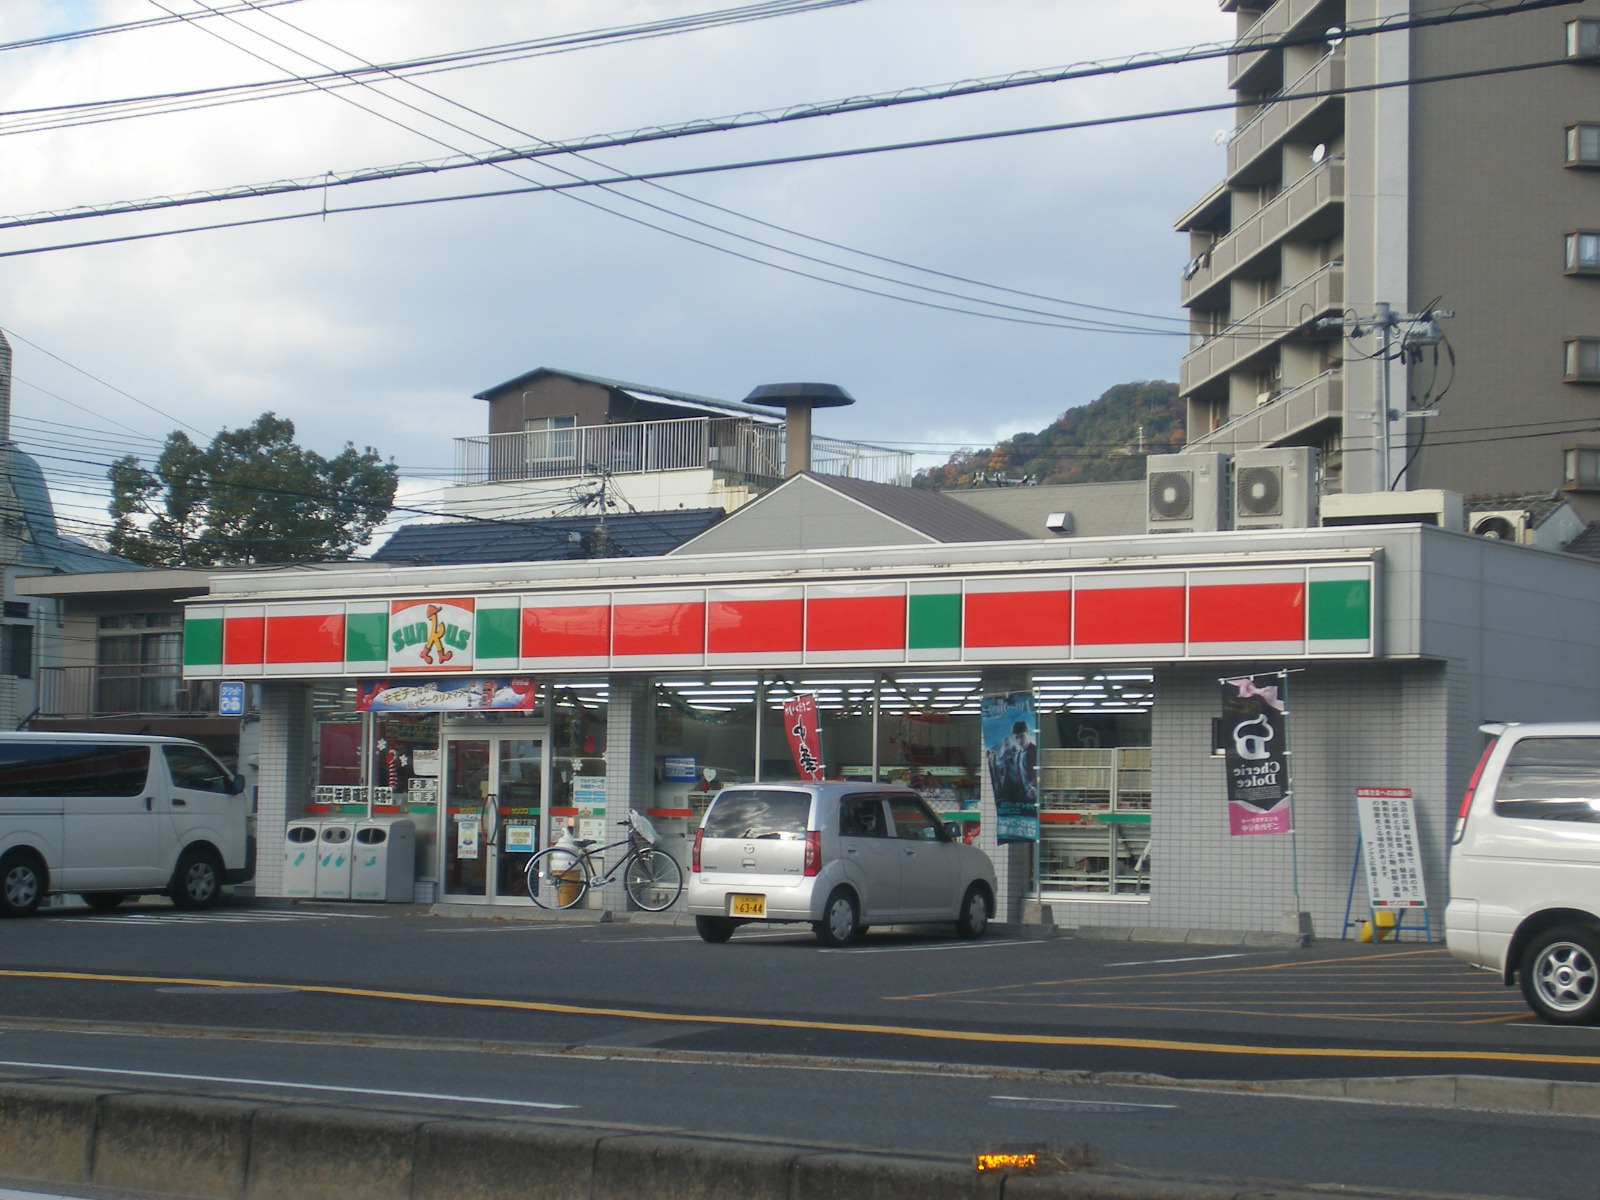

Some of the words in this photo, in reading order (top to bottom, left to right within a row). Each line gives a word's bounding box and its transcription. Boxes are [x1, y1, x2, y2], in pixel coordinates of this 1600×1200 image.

[383, 682, 437, 704] キモチつながる
[407, 688, 466, 709] ハッピークリスマス
[739, 903, 763, 914] 63-44
